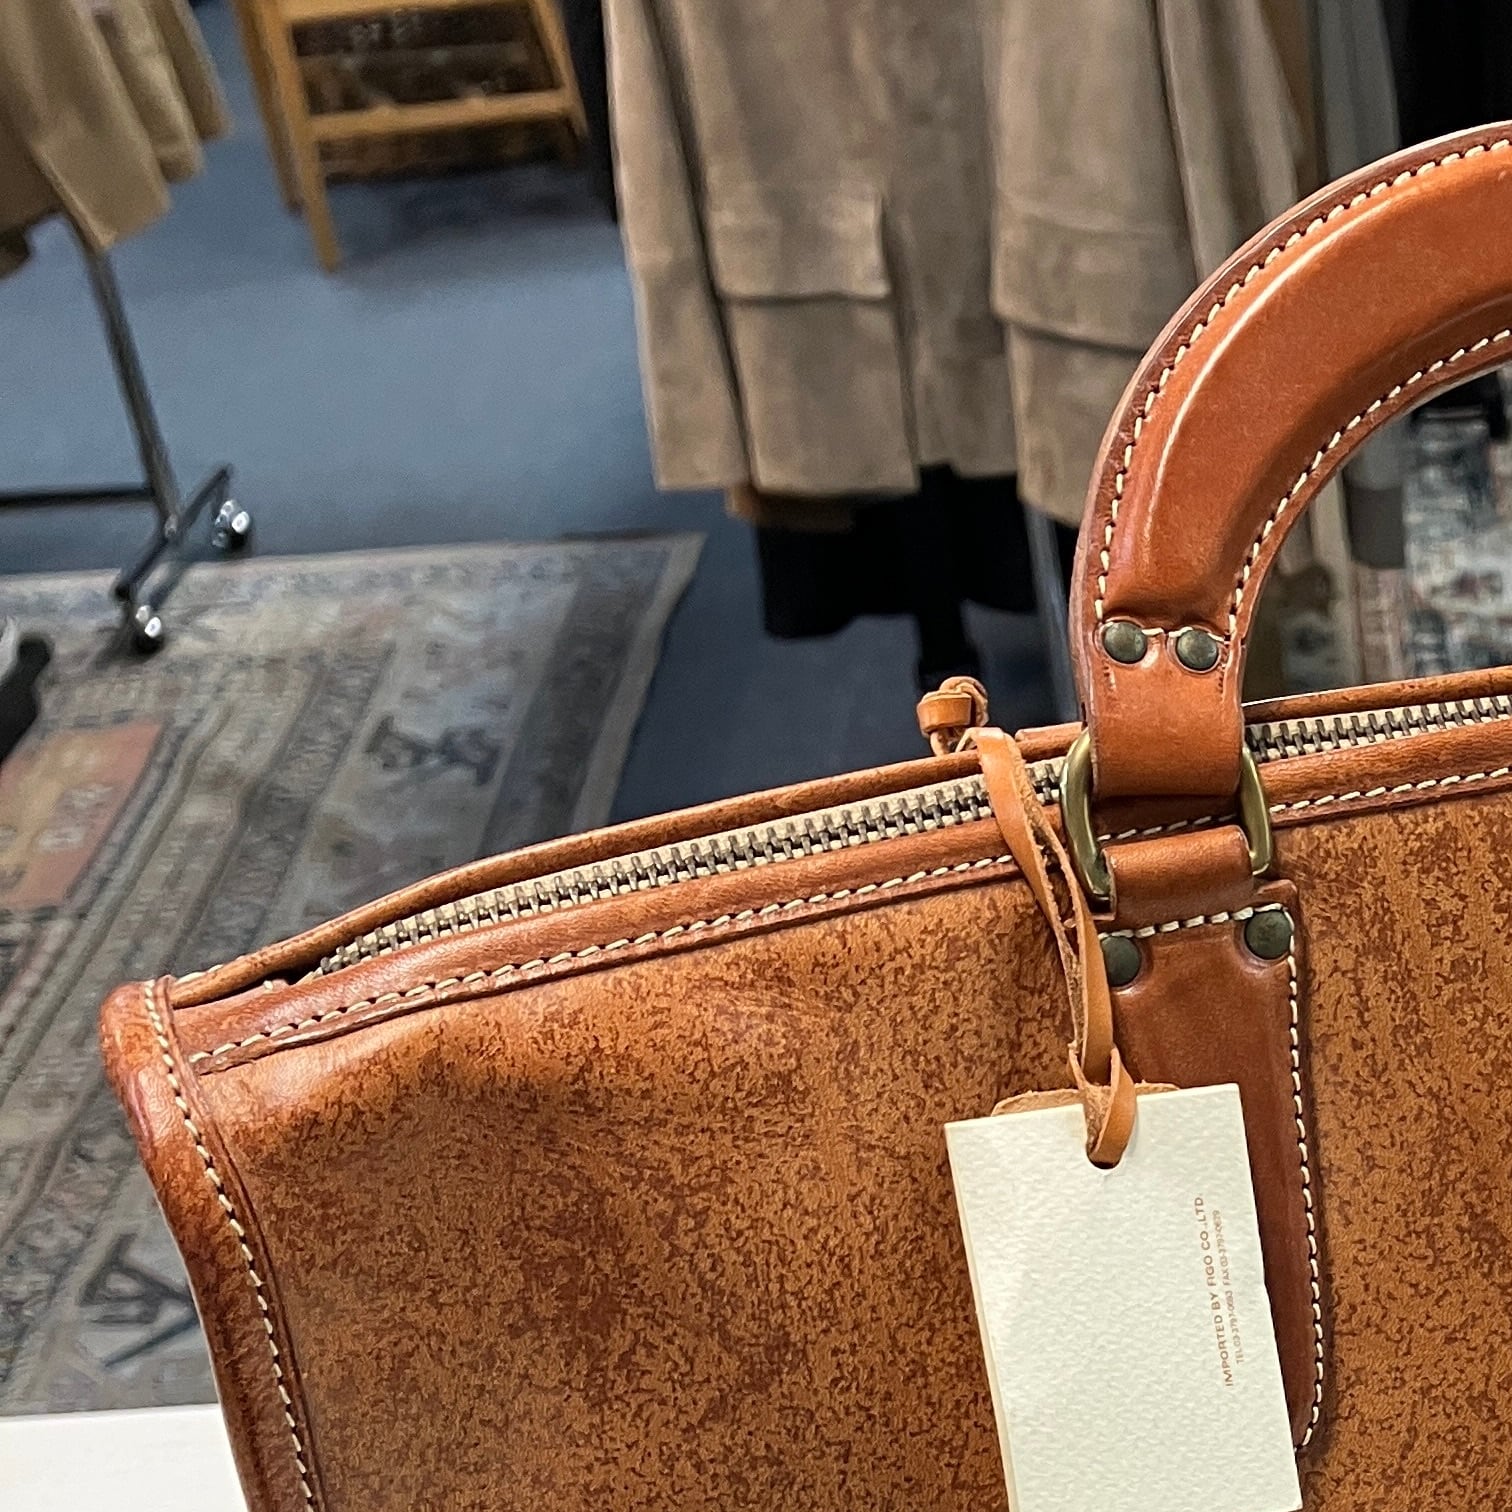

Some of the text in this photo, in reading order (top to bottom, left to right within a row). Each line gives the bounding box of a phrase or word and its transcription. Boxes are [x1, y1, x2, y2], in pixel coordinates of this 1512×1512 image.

[1203, 1255, 1217, 1287] FIGO
[1210, 1292, 1221, 1311] BY
[1213, 1314, 1233, 1387] IMPORTED
